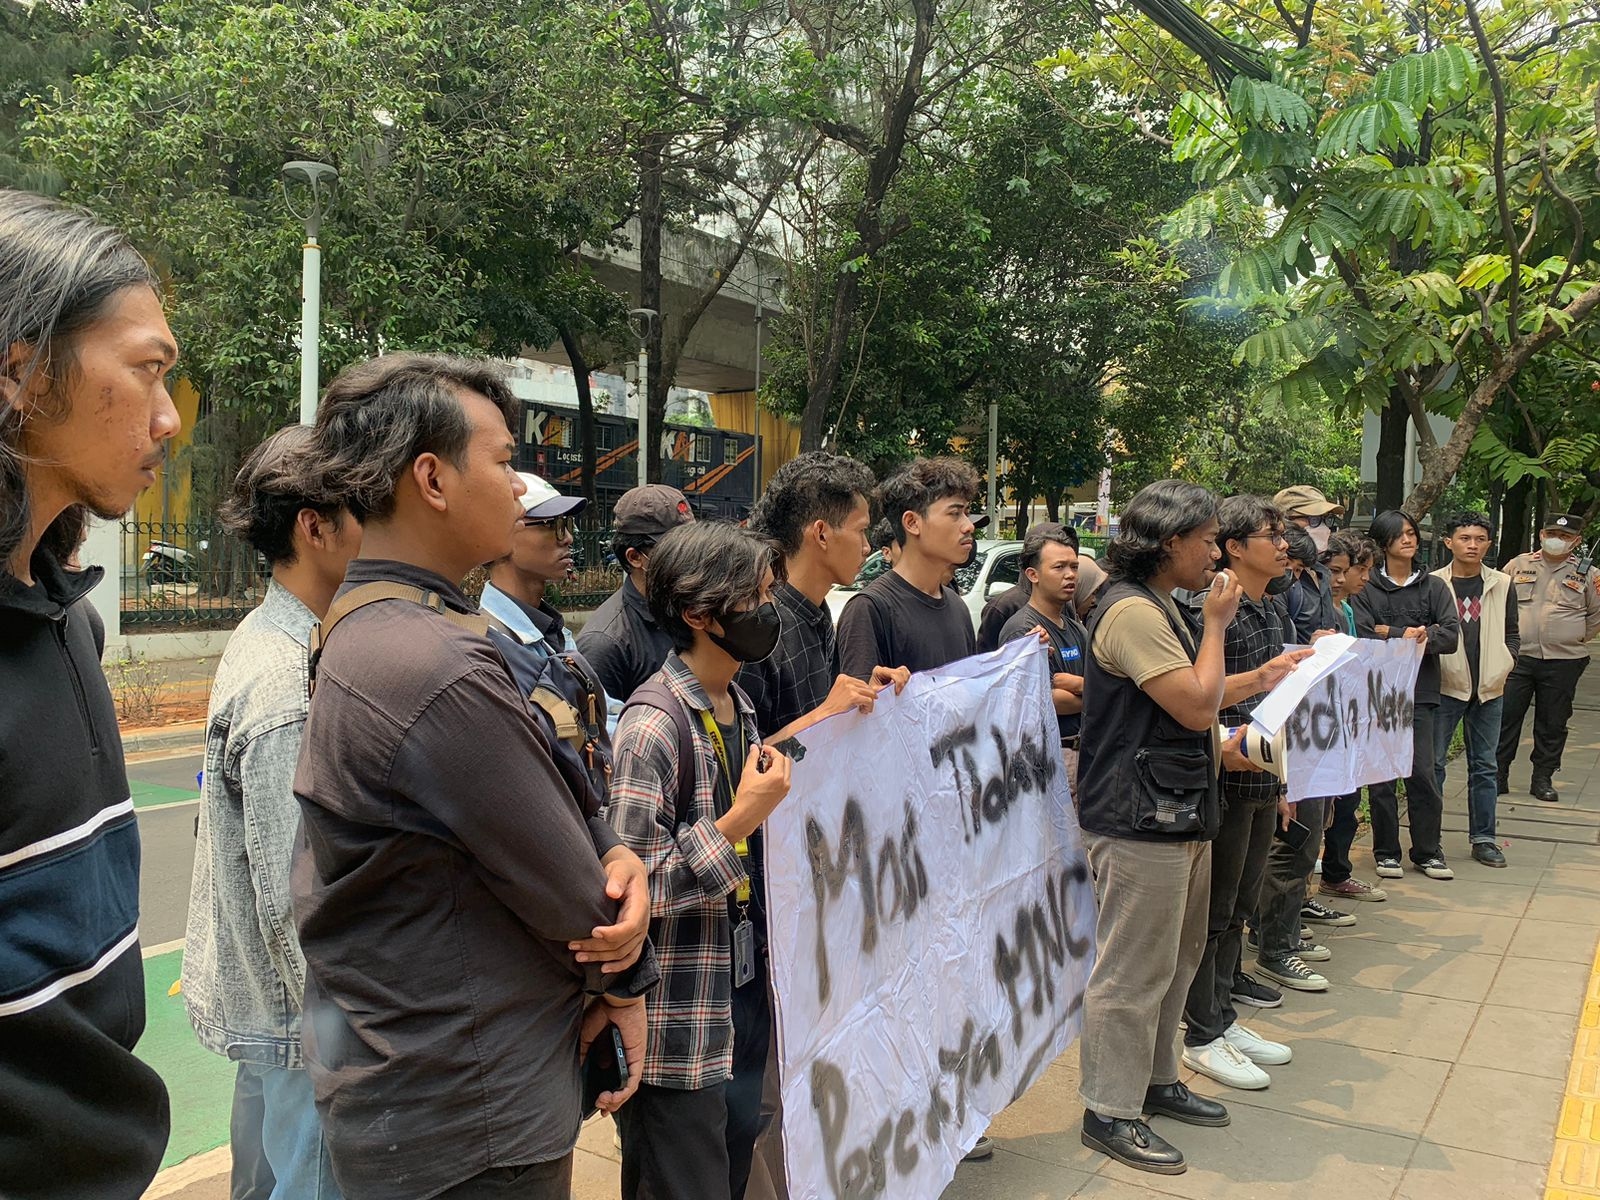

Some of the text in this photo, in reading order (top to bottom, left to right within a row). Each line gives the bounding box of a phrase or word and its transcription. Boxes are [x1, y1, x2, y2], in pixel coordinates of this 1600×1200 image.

[660, 429, 695, 462] KAI
[1565, 574, 1586, 584] POLRI
[995, 862, 1090, 1048] MNC
